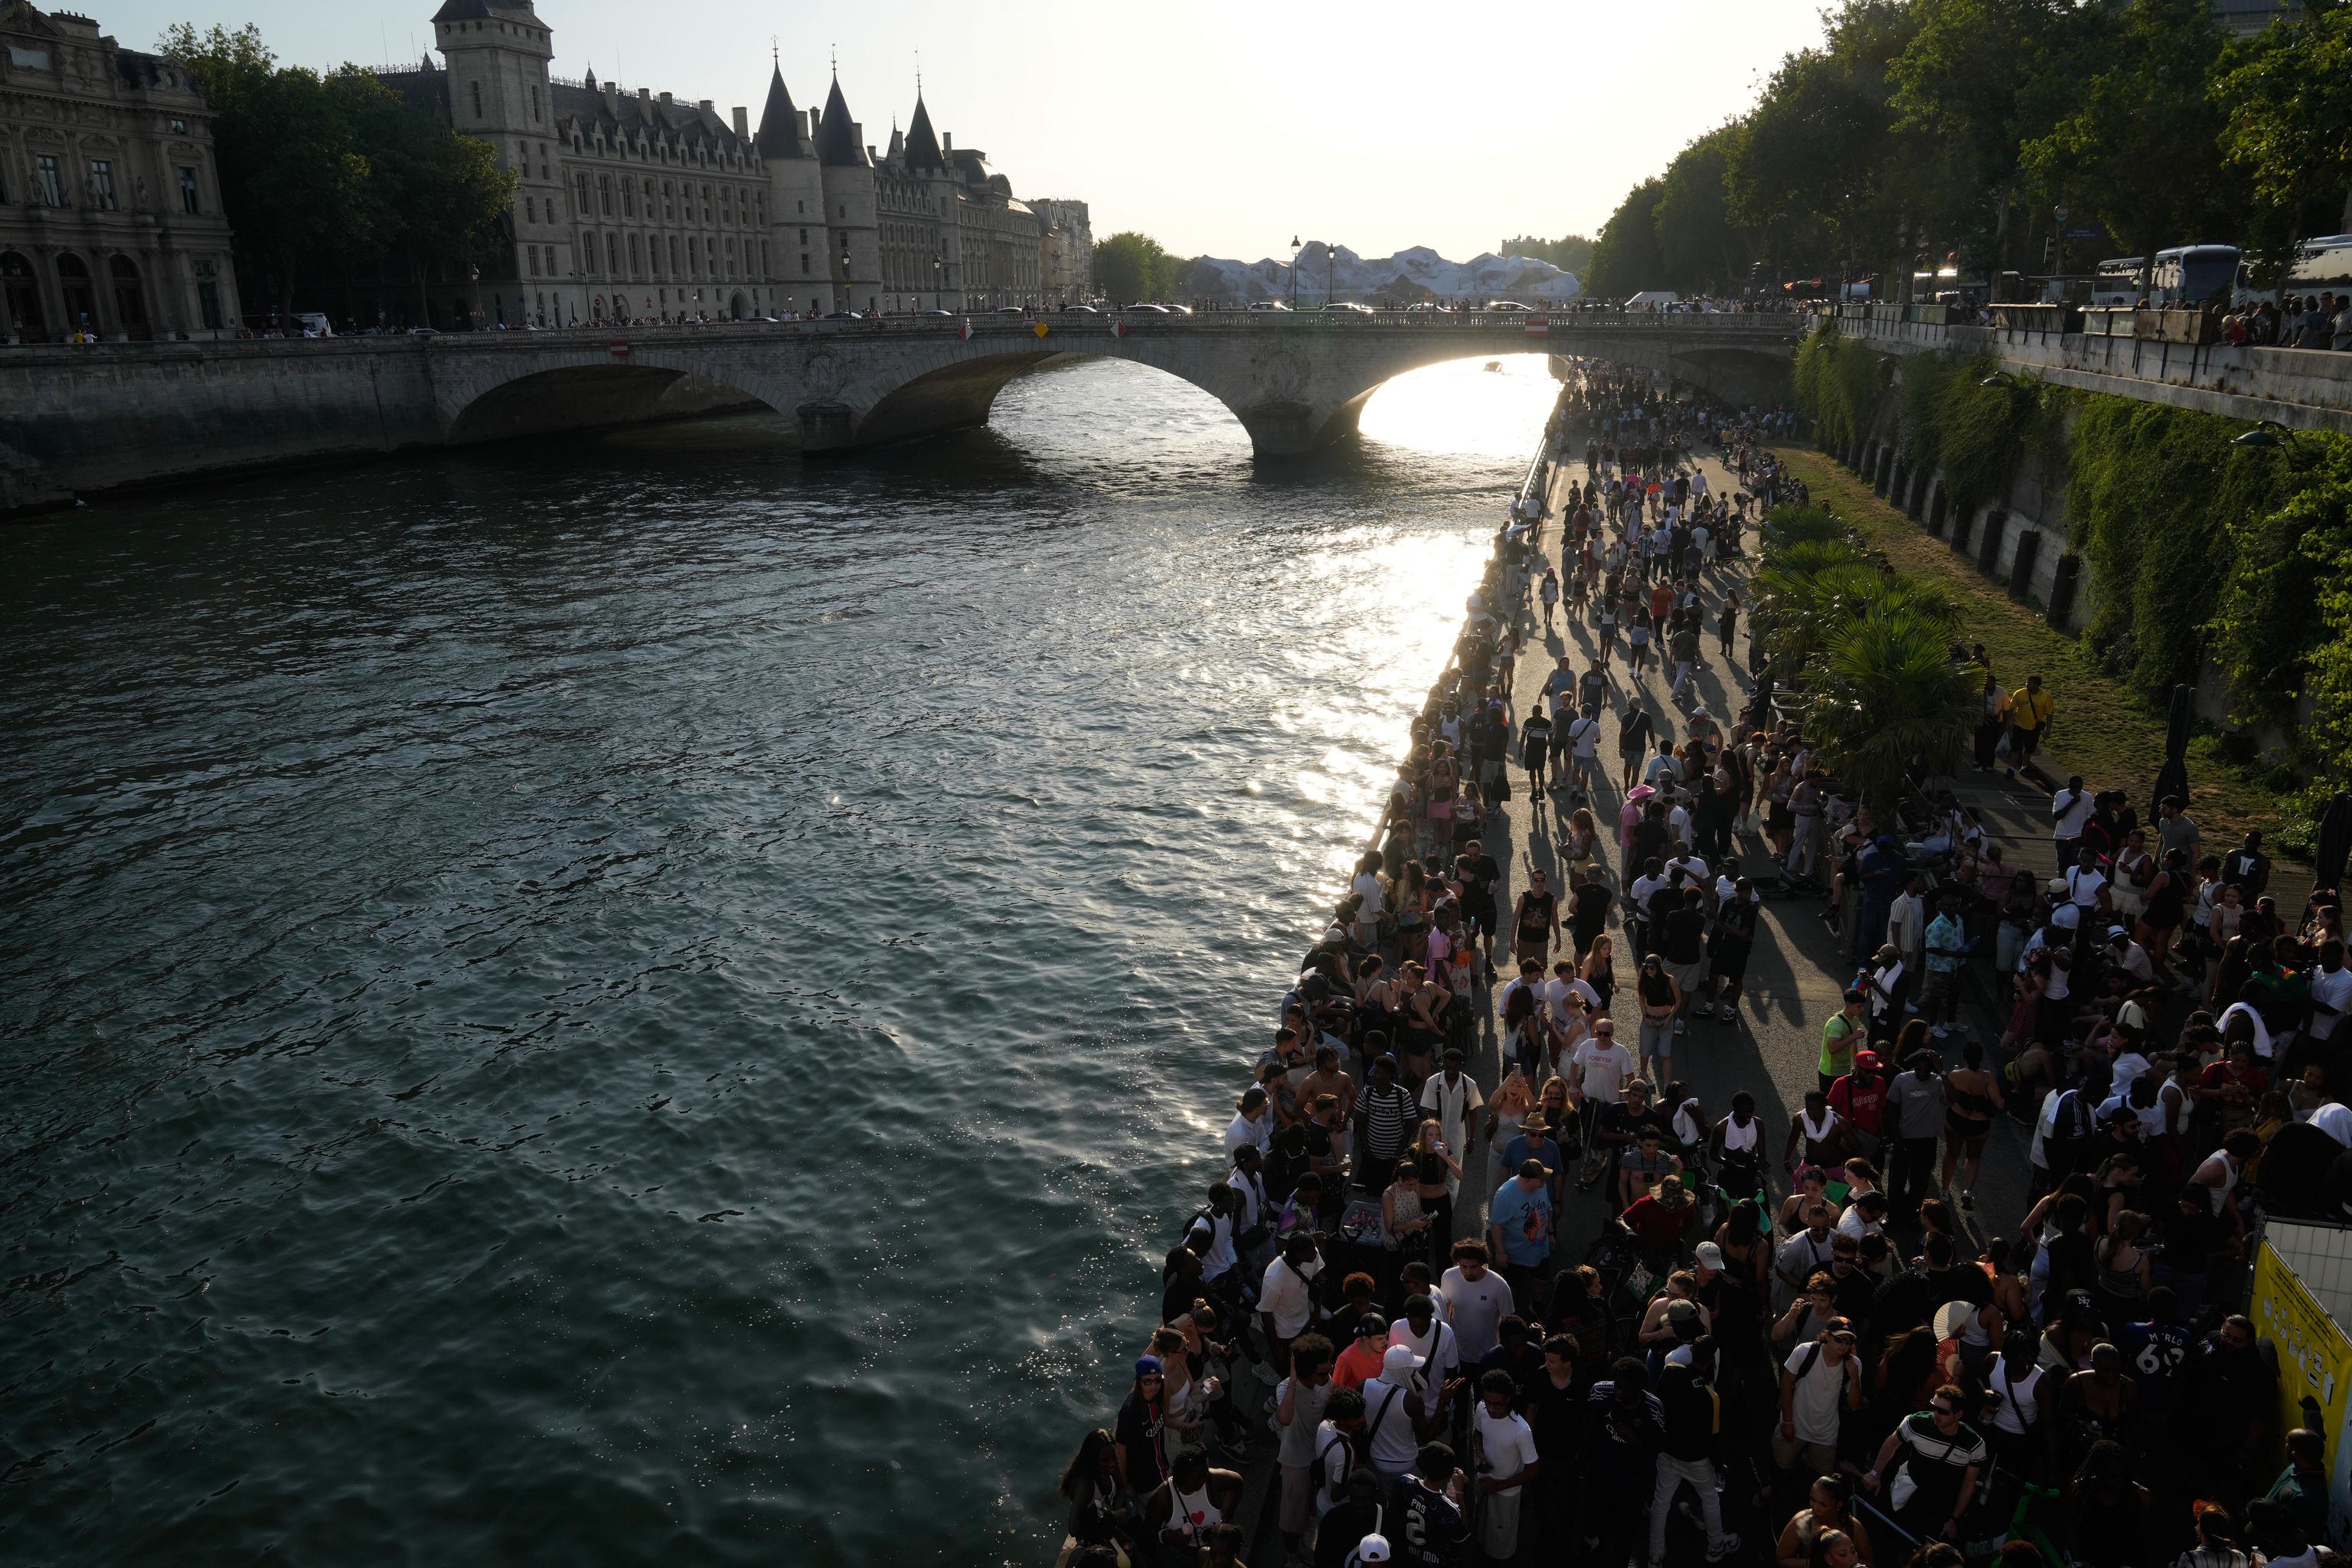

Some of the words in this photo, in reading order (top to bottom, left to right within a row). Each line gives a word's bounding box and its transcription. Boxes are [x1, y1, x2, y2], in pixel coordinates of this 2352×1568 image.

[1587, 675, 1602, 686] RUN
[1521, 1198, 1547, 1219] Fender
[2076, 1295, 2091, 1308] NY
[2148, 1333, 2184, 1347] MRLO
[1410, 1498, 1427, 1514] PAS
[1406, 1509, 1428, 1547] 2
